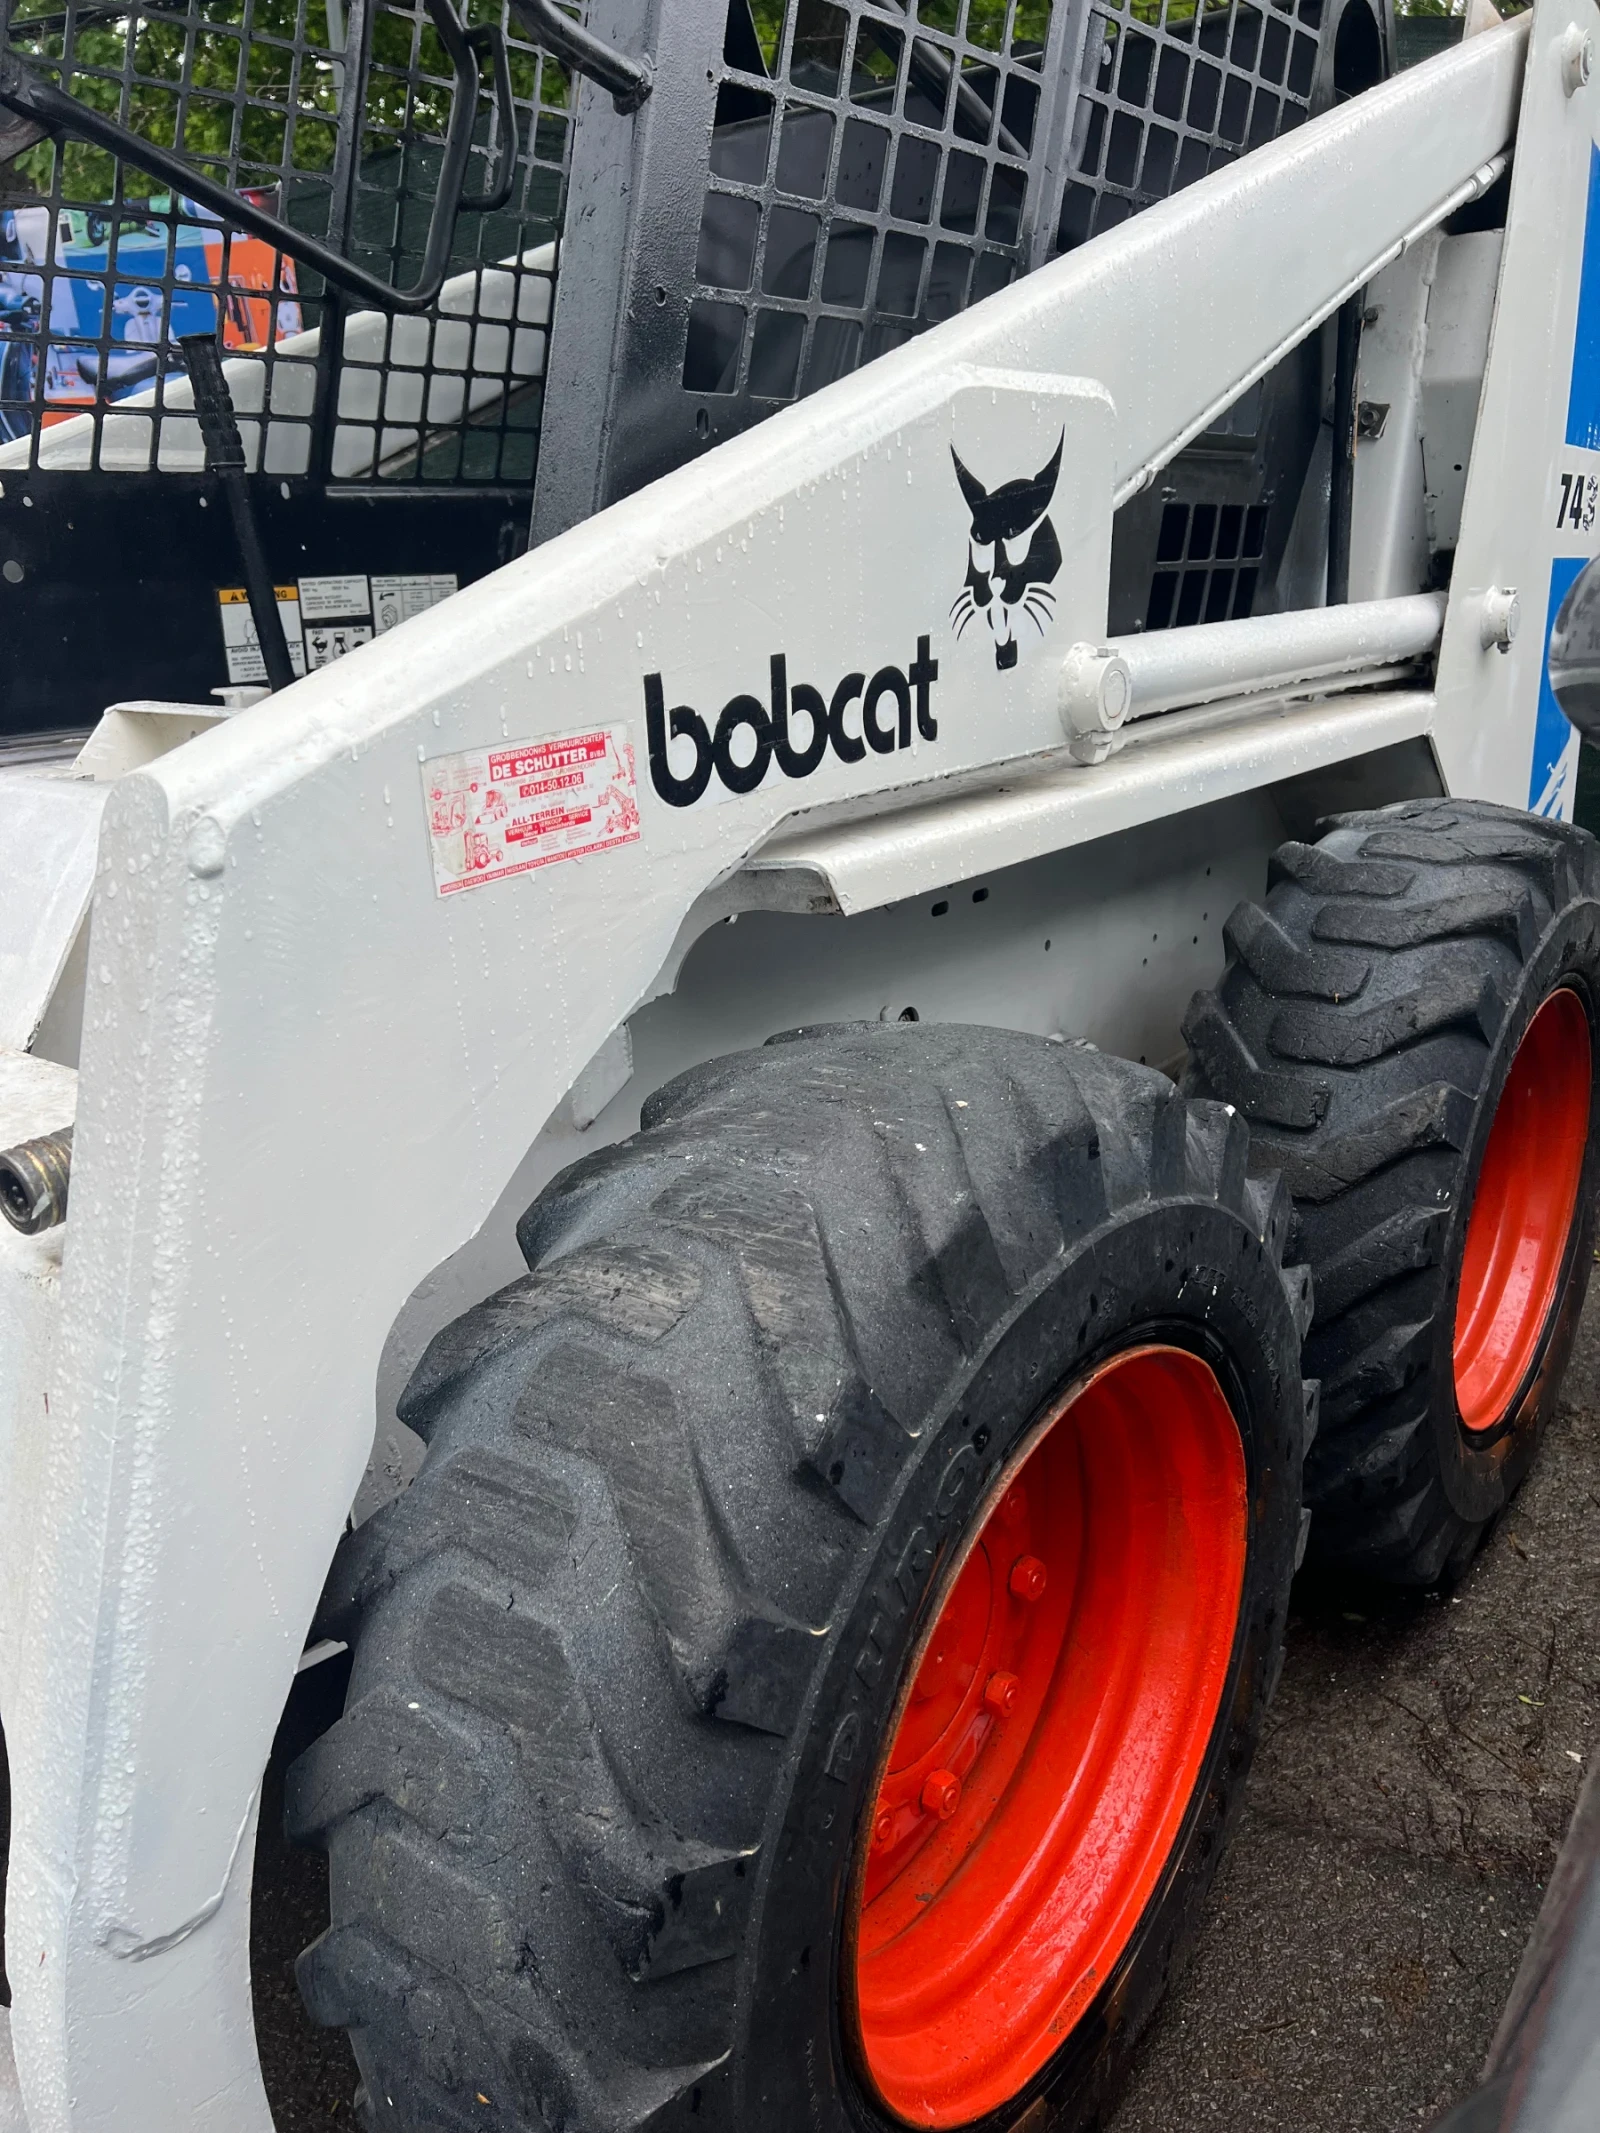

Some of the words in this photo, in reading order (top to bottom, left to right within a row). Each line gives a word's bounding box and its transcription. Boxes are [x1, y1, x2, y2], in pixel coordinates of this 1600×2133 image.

[643, 634, 939, 808] bobcat
[549, 733, 603, 751] VERHUURCENTER
[492, 763, 510, 779] DE
[515, 747, 587, 774] SCHUTTER
[511, 807, 565, 826] ALL-TERREIN
